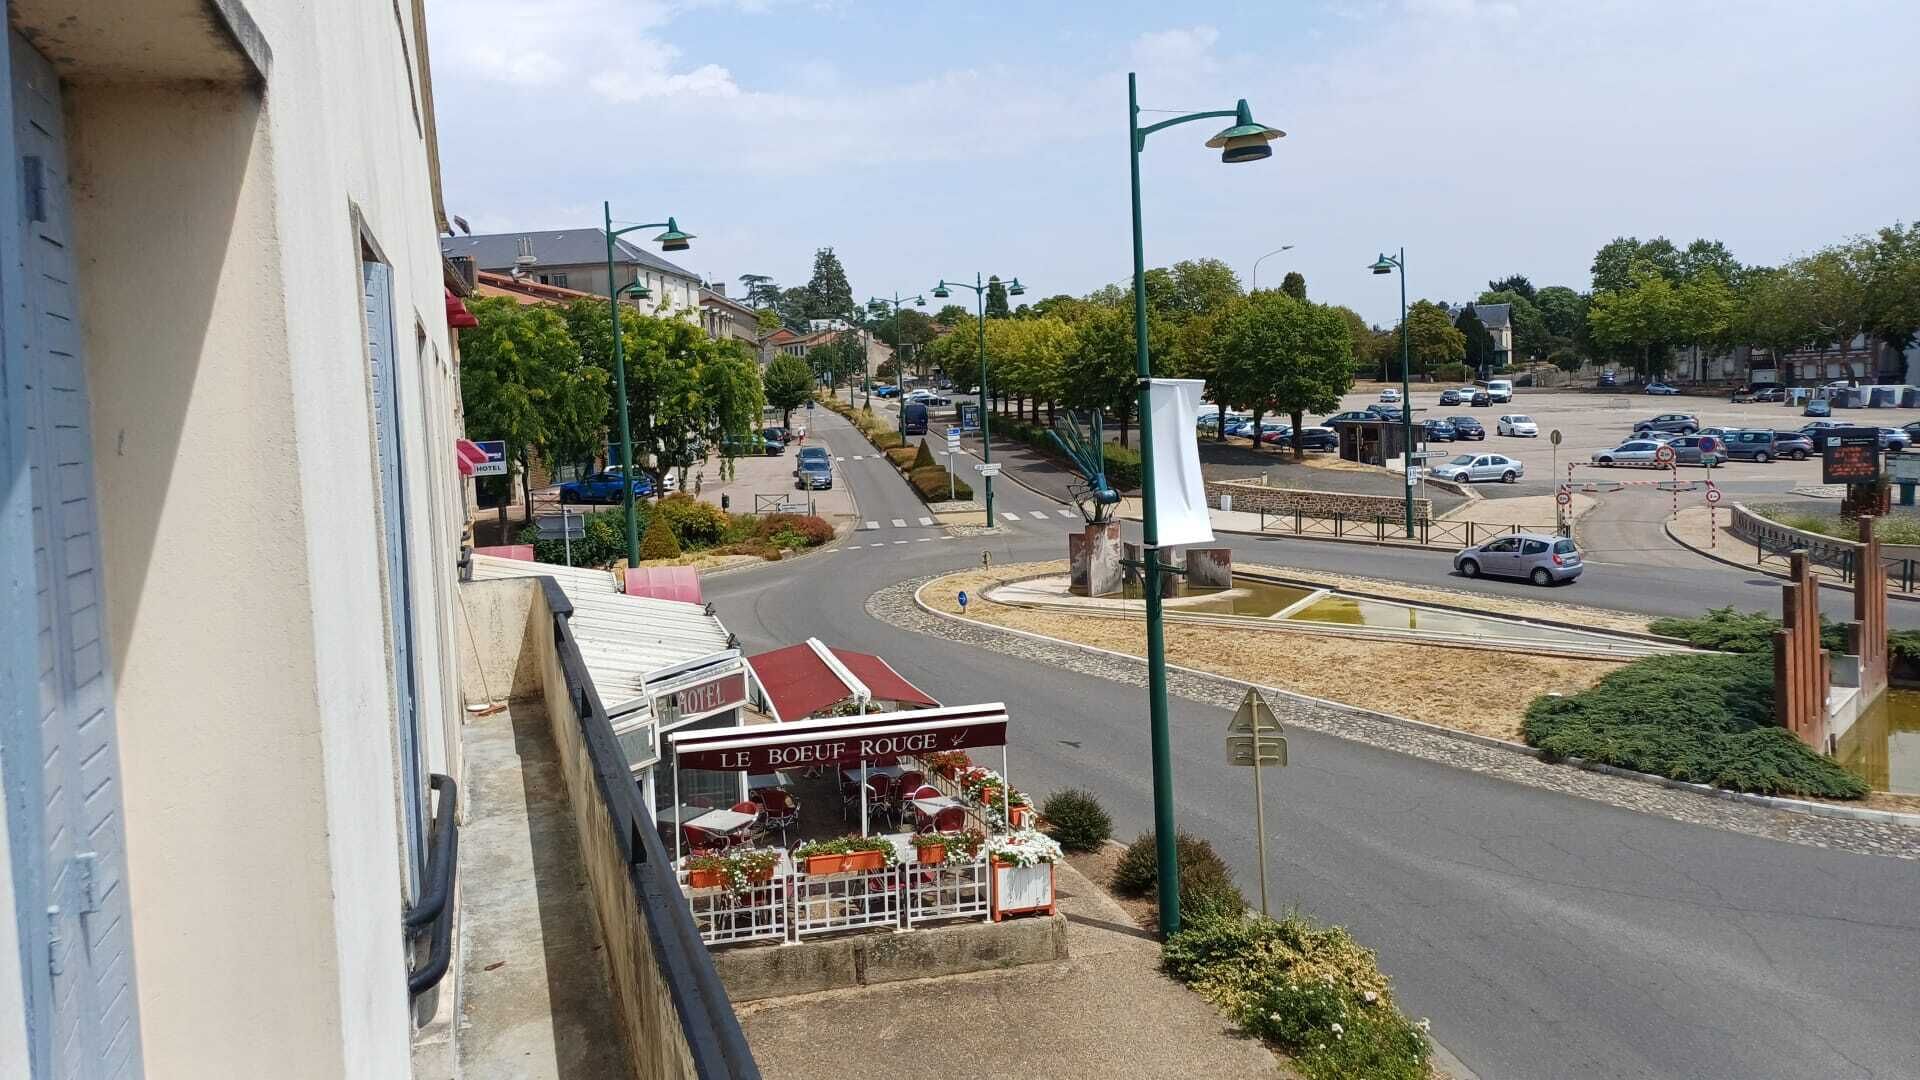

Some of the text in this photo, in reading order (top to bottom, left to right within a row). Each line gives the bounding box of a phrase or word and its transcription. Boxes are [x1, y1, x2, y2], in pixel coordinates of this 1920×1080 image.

[677, 682, 725, 715] HOTEL
[720, 733, 937, 768] LE BOEUF ROUGE
